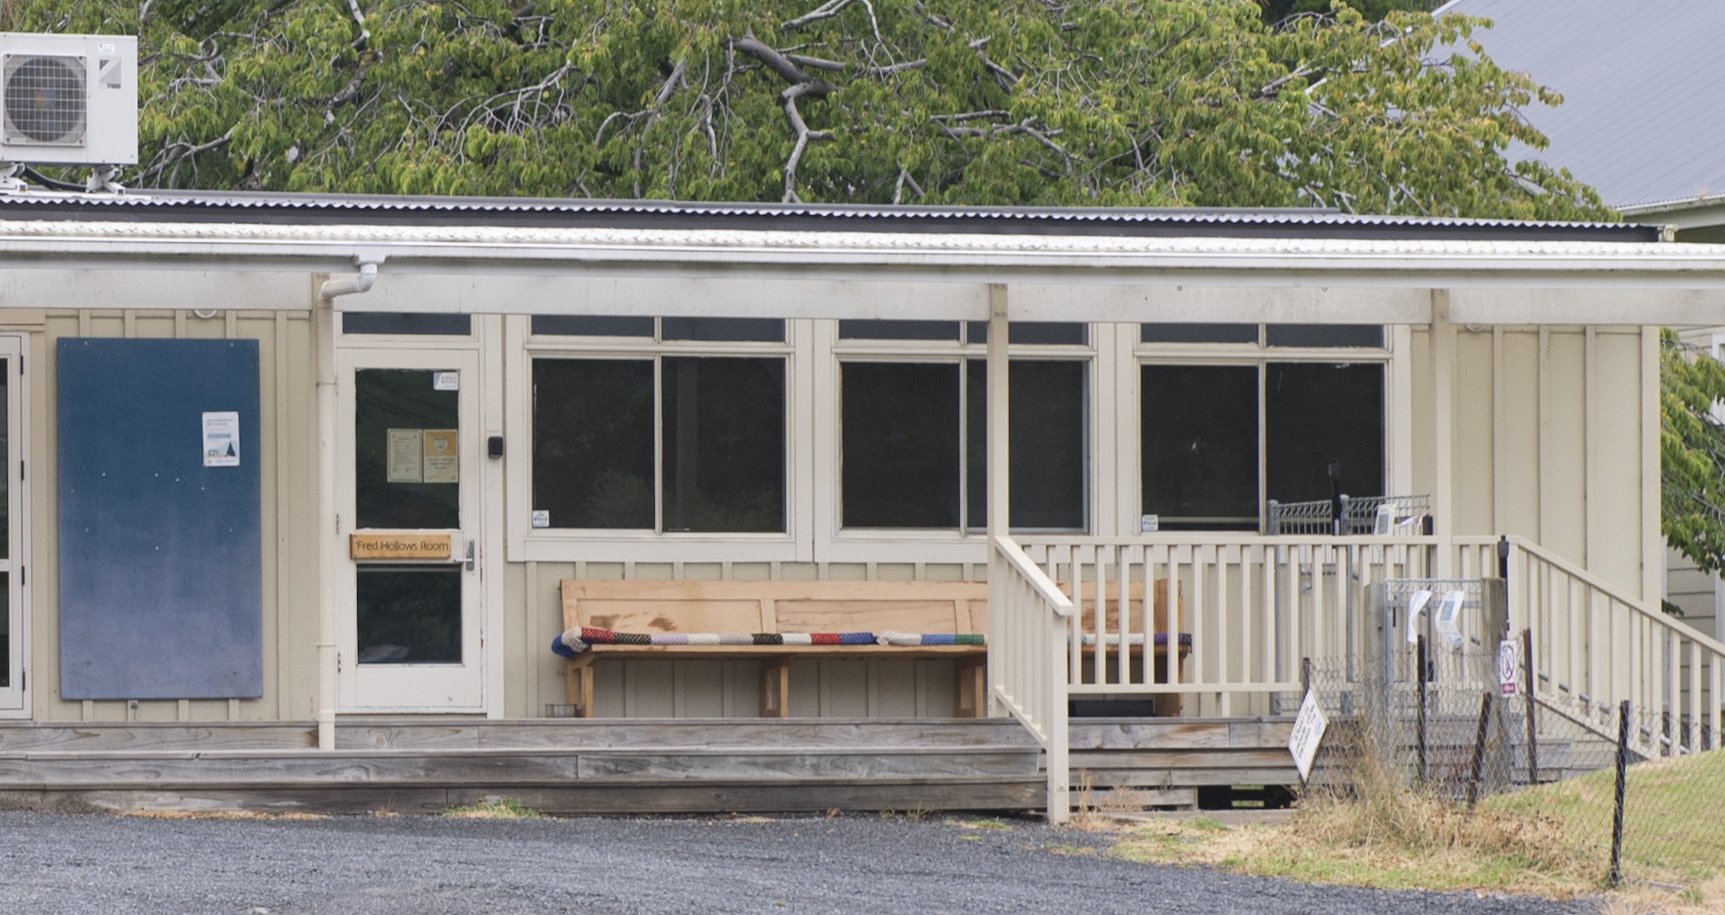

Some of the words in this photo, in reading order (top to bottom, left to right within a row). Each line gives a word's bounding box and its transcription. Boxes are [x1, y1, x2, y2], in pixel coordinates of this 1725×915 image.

[356, 540, 378, 551] Fred
[380, 540, 418, 551] Hollows
[420, 540, 449, 551] Room
